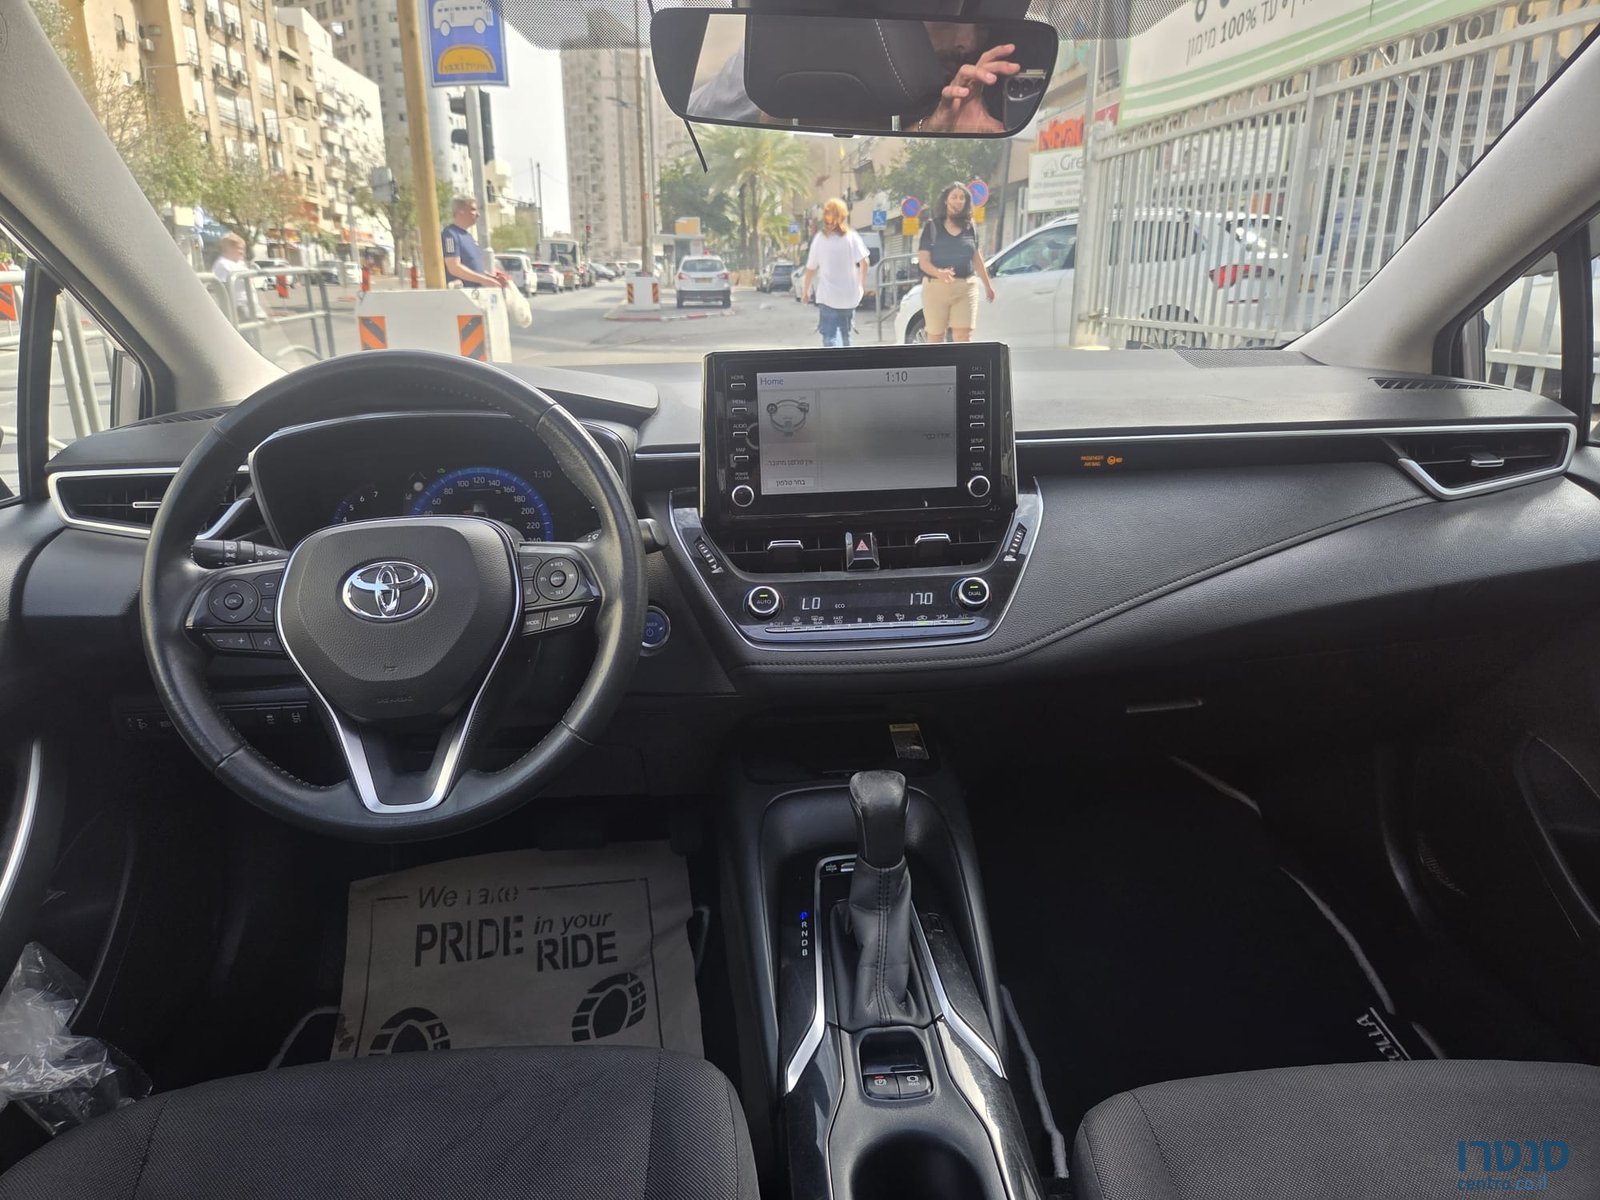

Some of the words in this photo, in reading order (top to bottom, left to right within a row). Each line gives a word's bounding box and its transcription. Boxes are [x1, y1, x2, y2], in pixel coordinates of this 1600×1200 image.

[1220, 6, 1257, 44] 100%
[1186, 27, 1216, 66] מימון
[760, 376, 784, 385] Home
[885, 371, 908, 382] 1:10
[457, 480, 469, 488] 100
[473, 476, 485, 484] 120
[513, 495, 525, 503] 180
[521, 507, 535, 515] 200
[802, 597, 821, 610] LO
[419, 886, 457, 908] We
[415, 915, 524, 968] PRIDE
[533, 916, 554, 935] in
[561, 912, 613, 935] your
[537, 931, 618, 972] RIDE
